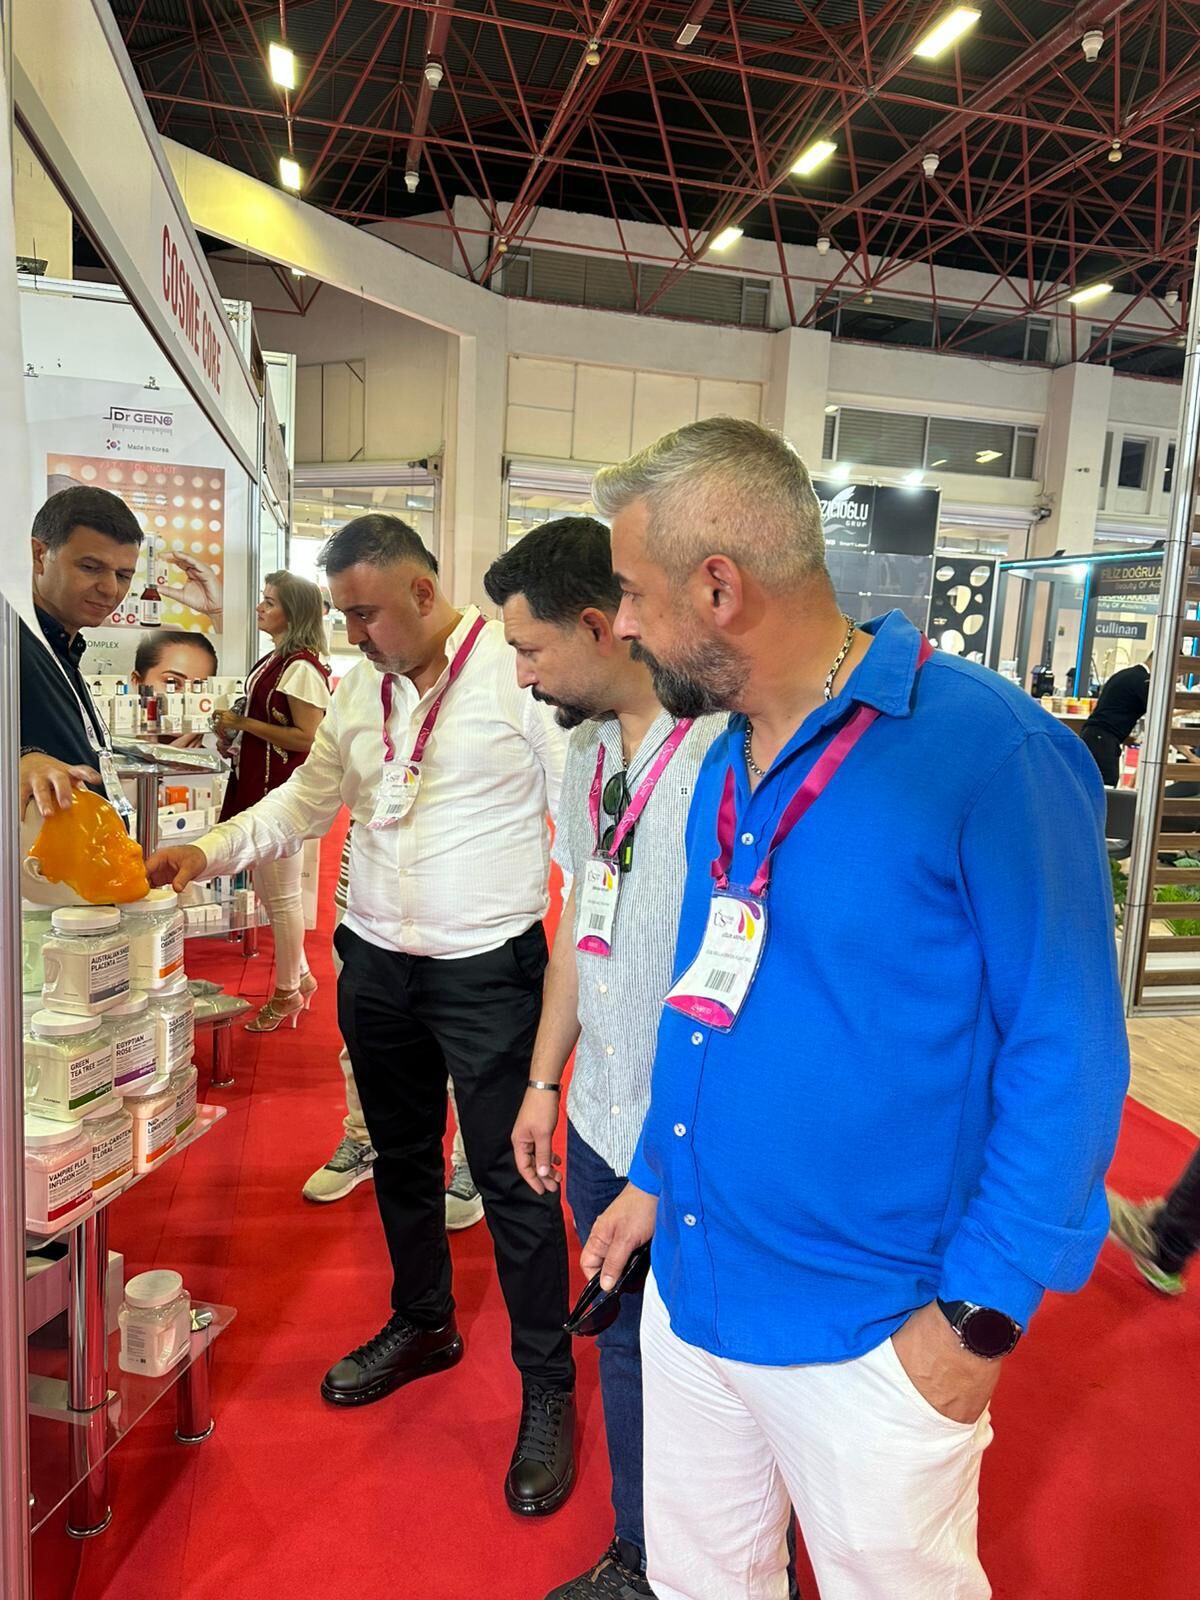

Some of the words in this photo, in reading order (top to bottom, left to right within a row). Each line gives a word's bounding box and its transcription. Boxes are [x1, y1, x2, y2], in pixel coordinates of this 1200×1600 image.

[162, 225, 201, 358] COSME
[202, 310, 221, 396] CORE
[114, 411, 130, 421] Dr
[133, 413, 173, 426] GENO
[127, 443, 144, 451] Made
[820, 500, 869, 521] ZICIOĞLU
[1122, 565, 1155, 578] DOĞRU
[1095, 622, 1138, 635] cullinan
[87, 639, 119, 649] OMPLEX
[91, 951, 119, 964] AUSTRALIAN
[91, 959, 116, 971] PLACENTA
[116, 1034, 144, 1050] EGYPTIAN
[116, 1046, 132, 1057] ROSE
[70, 1058, 90, 1071] GREEN
[71, 1068, 82, 1079] TEA
[82, 1062, 96, 1074] TREE
[92, 1146, 113, 1161] FLORAL
[48, 1163, 74, 1182] VAMPIRE
[48, 1173, 76, 1190] INFUSION
